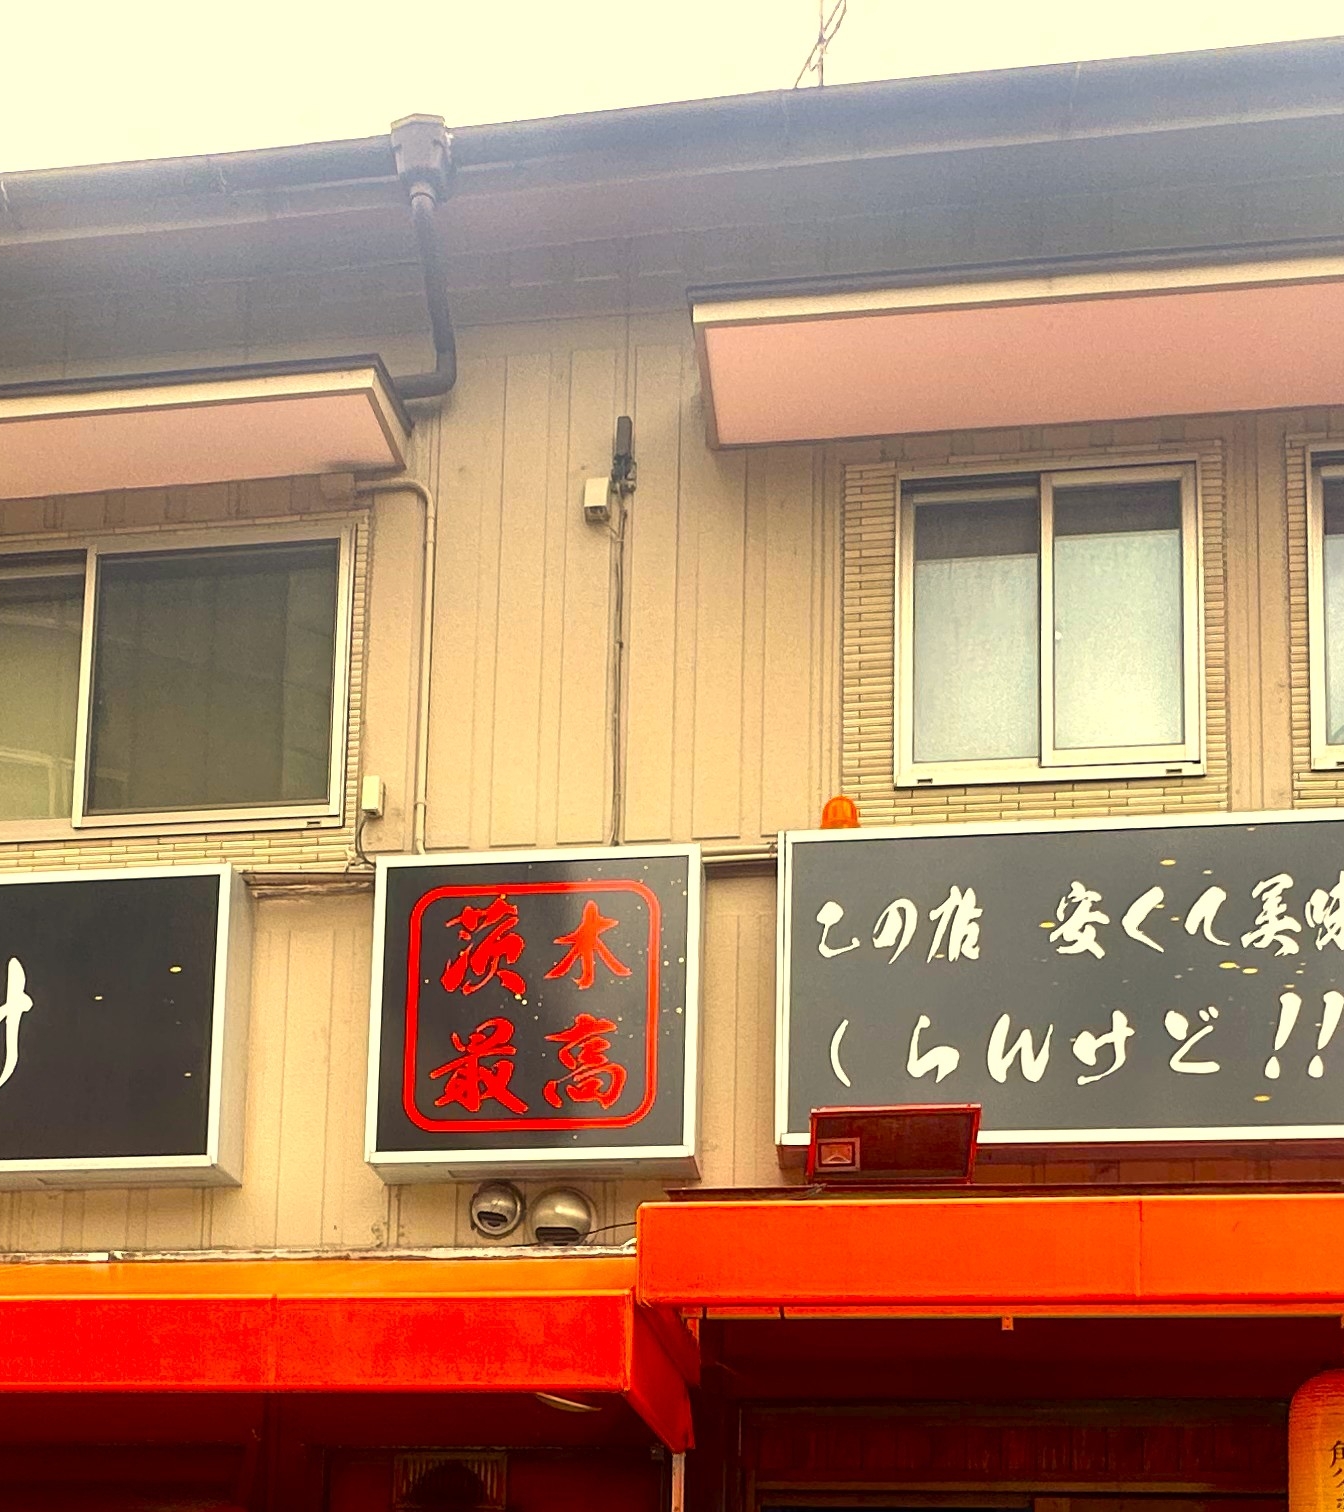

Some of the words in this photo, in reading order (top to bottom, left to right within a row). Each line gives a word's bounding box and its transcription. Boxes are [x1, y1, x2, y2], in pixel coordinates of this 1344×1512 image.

[439, 895, 633, 996] 茨木
[816, 884, 984, 964] この店
[428, 1013, 629, 1115] 最高
